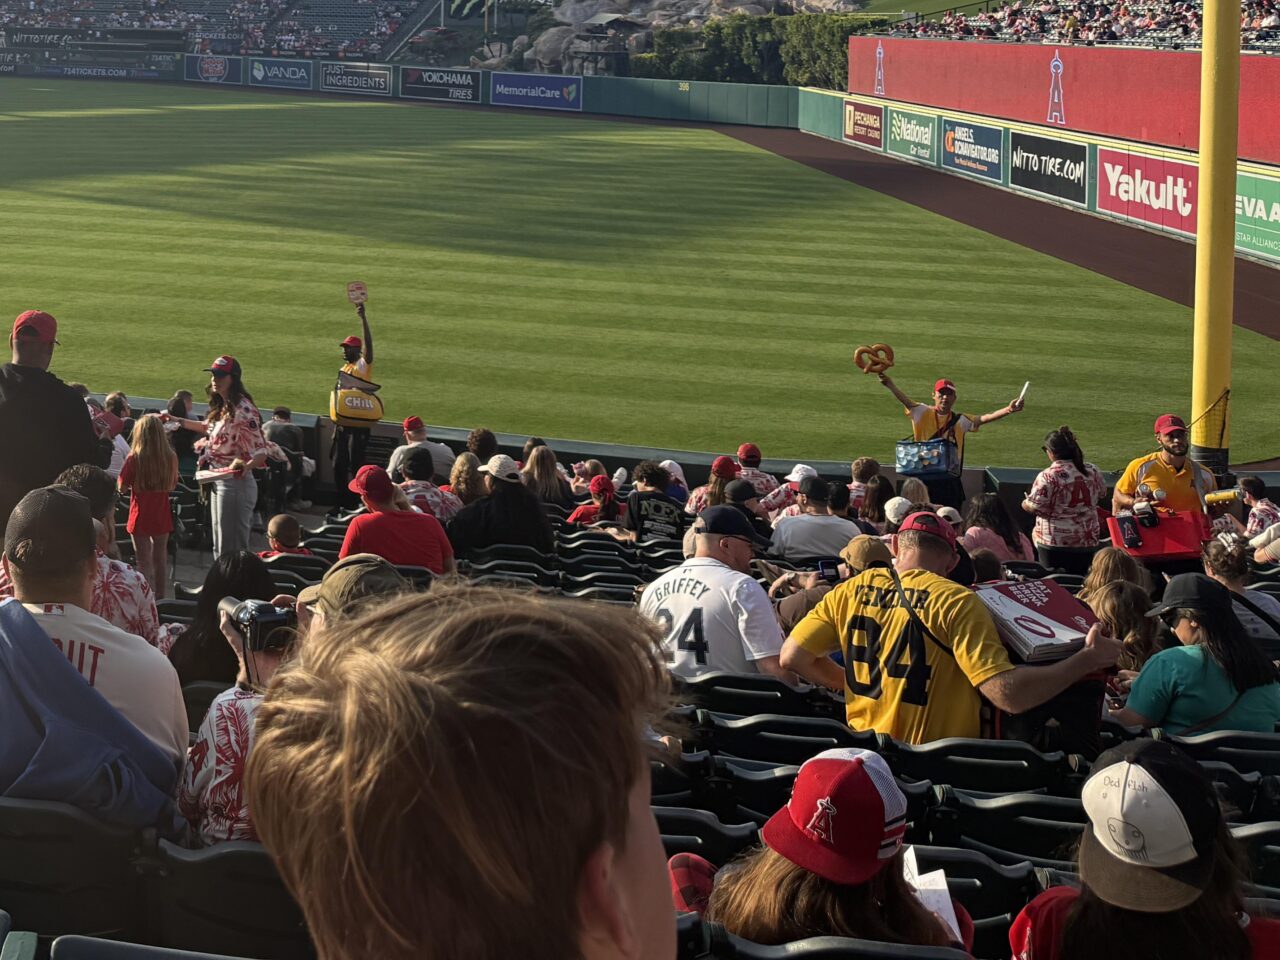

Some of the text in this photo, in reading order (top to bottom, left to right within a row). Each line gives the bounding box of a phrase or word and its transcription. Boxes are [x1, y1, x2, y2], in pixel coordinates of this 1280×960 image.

[264, 67, 308, 80] VANDA
[326, 65, 345, 74] JUST
[326, 76, 385, 89] INGREDIENTS
[422, 71, 473, 86] YOKOHAMA
[448, 88, 473, 100] TIRES
[496, 84, 561, 99] MemorialCare
[854, 111, 881, 129] PECHANGA
[854, 125, 881, 140] RESORT CASINO
[900, 117, 933, 145] National
[909, 144, 919, 155] Car
[954, 140, 999, 164] OCNAVIGATOR.ORG
[1012, 146, 1085, 187] NITTO TIRE.COM
[1103, 162, 1193, 217] Yakult
[1236, 231, 1251, 243] STAR
[654, 577, 711, 603] GRIFFEY
[1008, 586, 1030, 604] BEER
[1017, 584, 1045, 607] DRINK
[1024, 582, 1049, 603] PIZZA
[1033, 581, 1052, 594] EAT
[844, 613, 933, 707] 84
